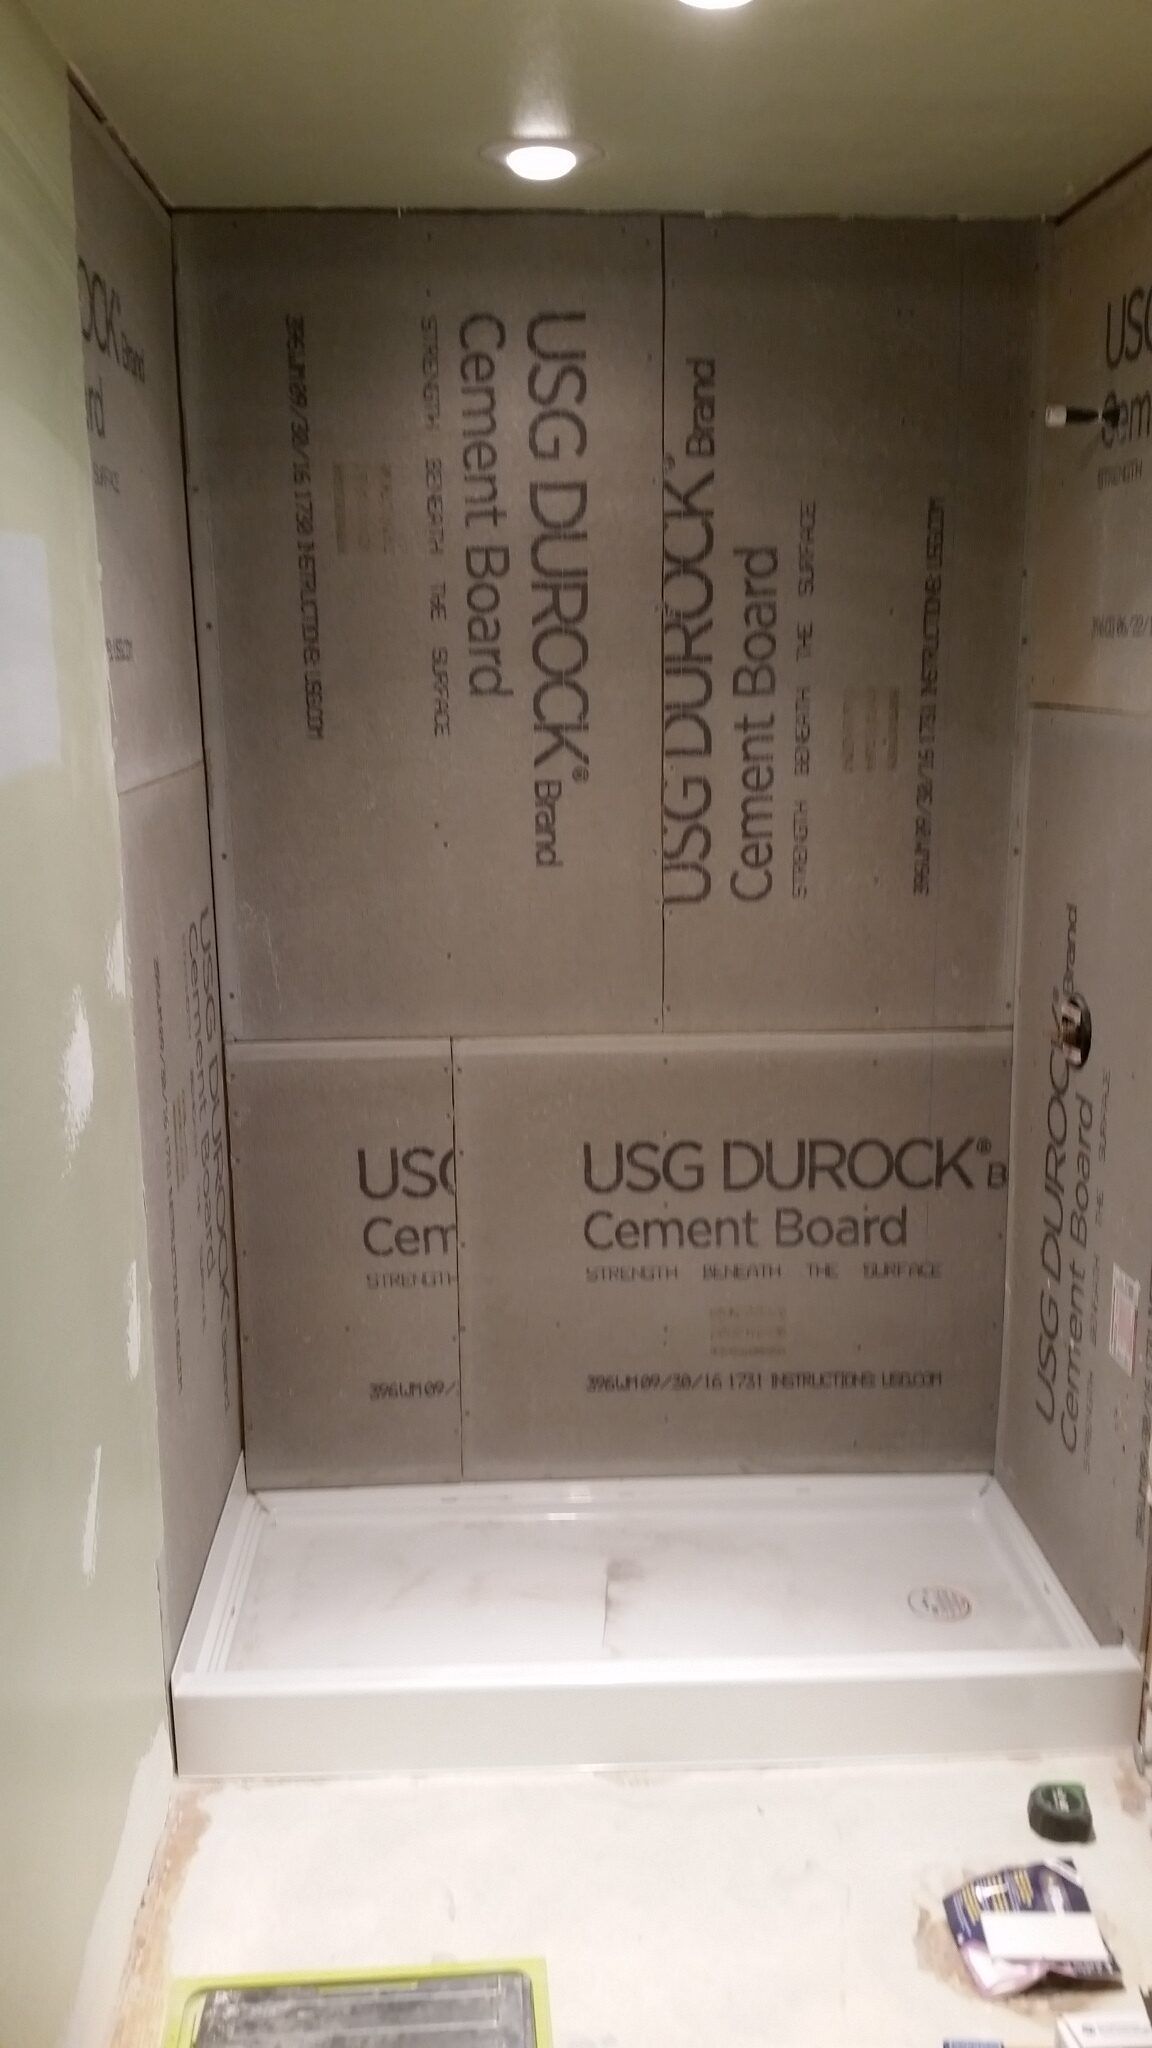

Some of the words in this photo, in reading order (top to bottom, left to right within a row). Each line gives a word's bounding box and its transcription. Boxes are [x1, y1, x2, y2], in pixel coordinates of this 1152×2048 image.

[420, 313, 441, 431] STRENGTH
[458, 311, 508, 528] Cement
[527, 311, 587, 460] USG
[685, 357, 716, 458] Brand
[425, 456, 444, 555] BENEATH
[798, 497, 816, 597] SURFACE
[429, 582, 447, 622] THE
[465, 545, 514, 697] Board
[732, 545, 779, 697] Board
[796, 620, 813, 663] THE
[431, 646, 450, 738] SURFACE
[794, 686, 811, 778] BENEATH
[534, 779, 564, 868] Brand
[663, 777, 713, 905] USG
[729, 713, 775, 902] Cement
[792, 800, 809, 900] STRENGTH
[200, 906, 216, 1043] USG
[188, 921, 207, 1114] Cement
[201, 1130, 216, 1279] Board
[583, 1140, 705, 1194] USG
[1035, 1288, 1060, 1424] USG
[1062, 902, 1078, 997] Brand
[1070, 1091, 1093, 1249] Board
[584, 1210, 759, 1250] Cement
[775, 1203, 908, 1249] Board
[585, 1265, 680, 1284] STRENGTH
[702, 1263, 783, 1282] BENEATH
[806, 1261, 839, 1280] THE
[862, 1259, 945, 1281] SURFACE
[728, 1371, 763, 1392] 1731
[1060, 1257, 1087, 1454] Cement
